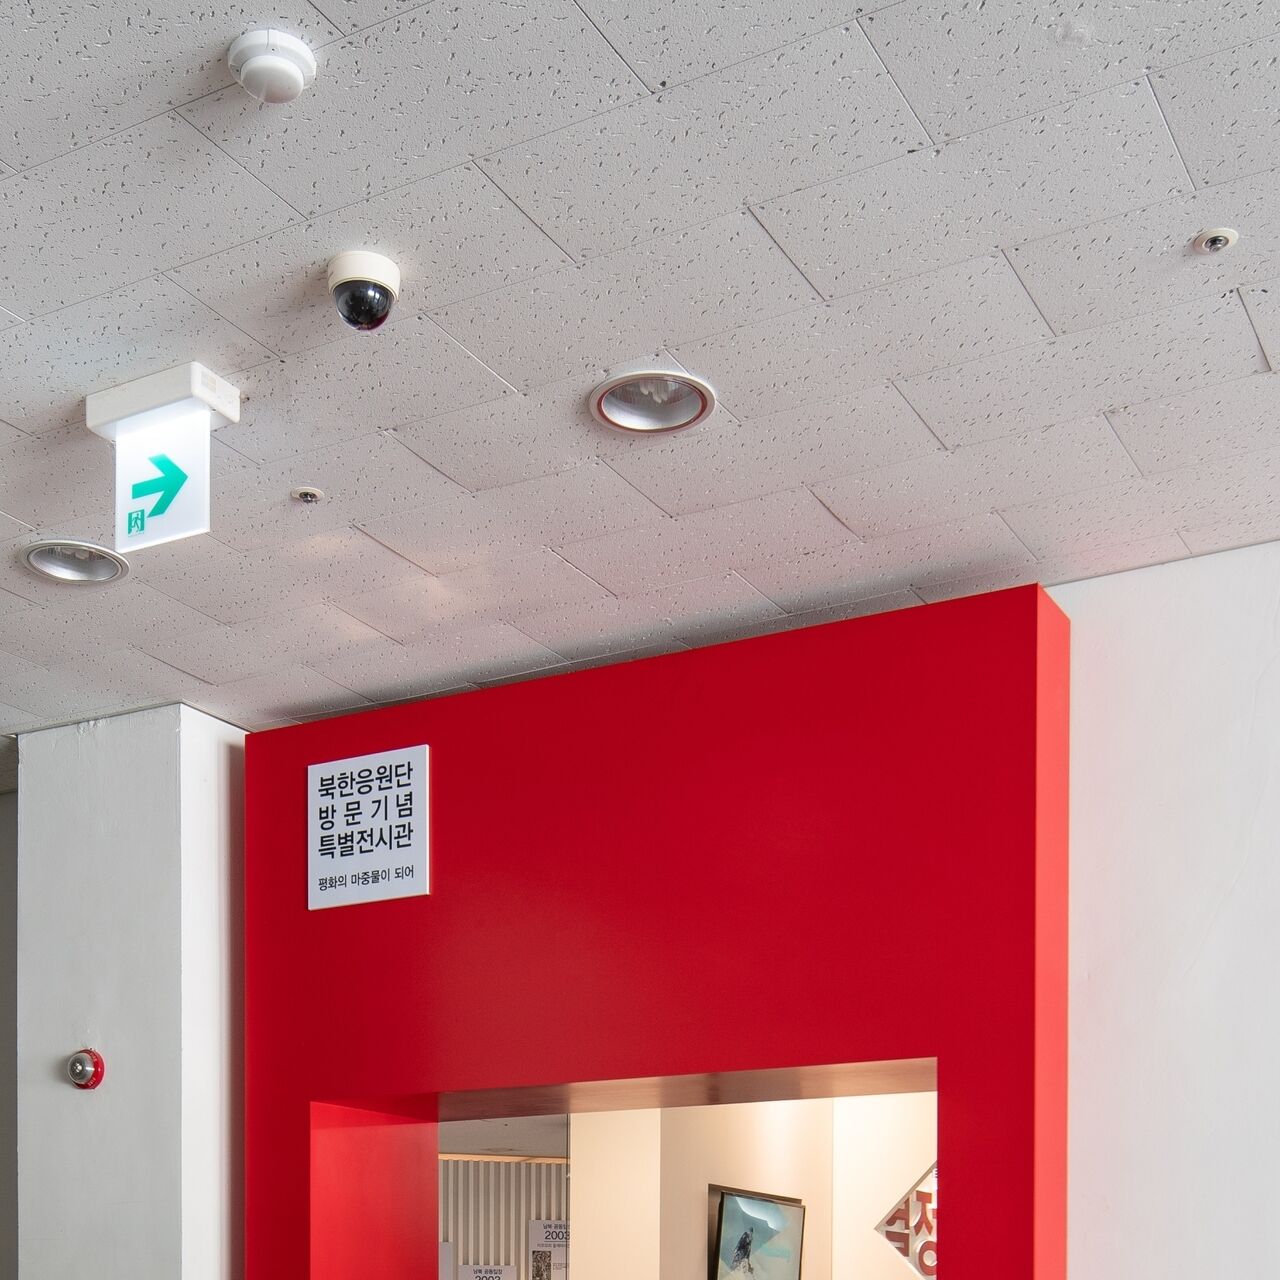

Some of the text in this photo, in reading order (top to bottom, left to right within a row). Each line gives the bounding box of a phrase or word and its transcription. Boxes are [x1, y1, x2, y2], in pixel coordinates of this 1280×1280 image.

[318, 761, 413, 800] 북한응원단
[318, 821, 414, 859] 특별전시관
[318, 864, 414, 891] 평화의 마중물이 되어
